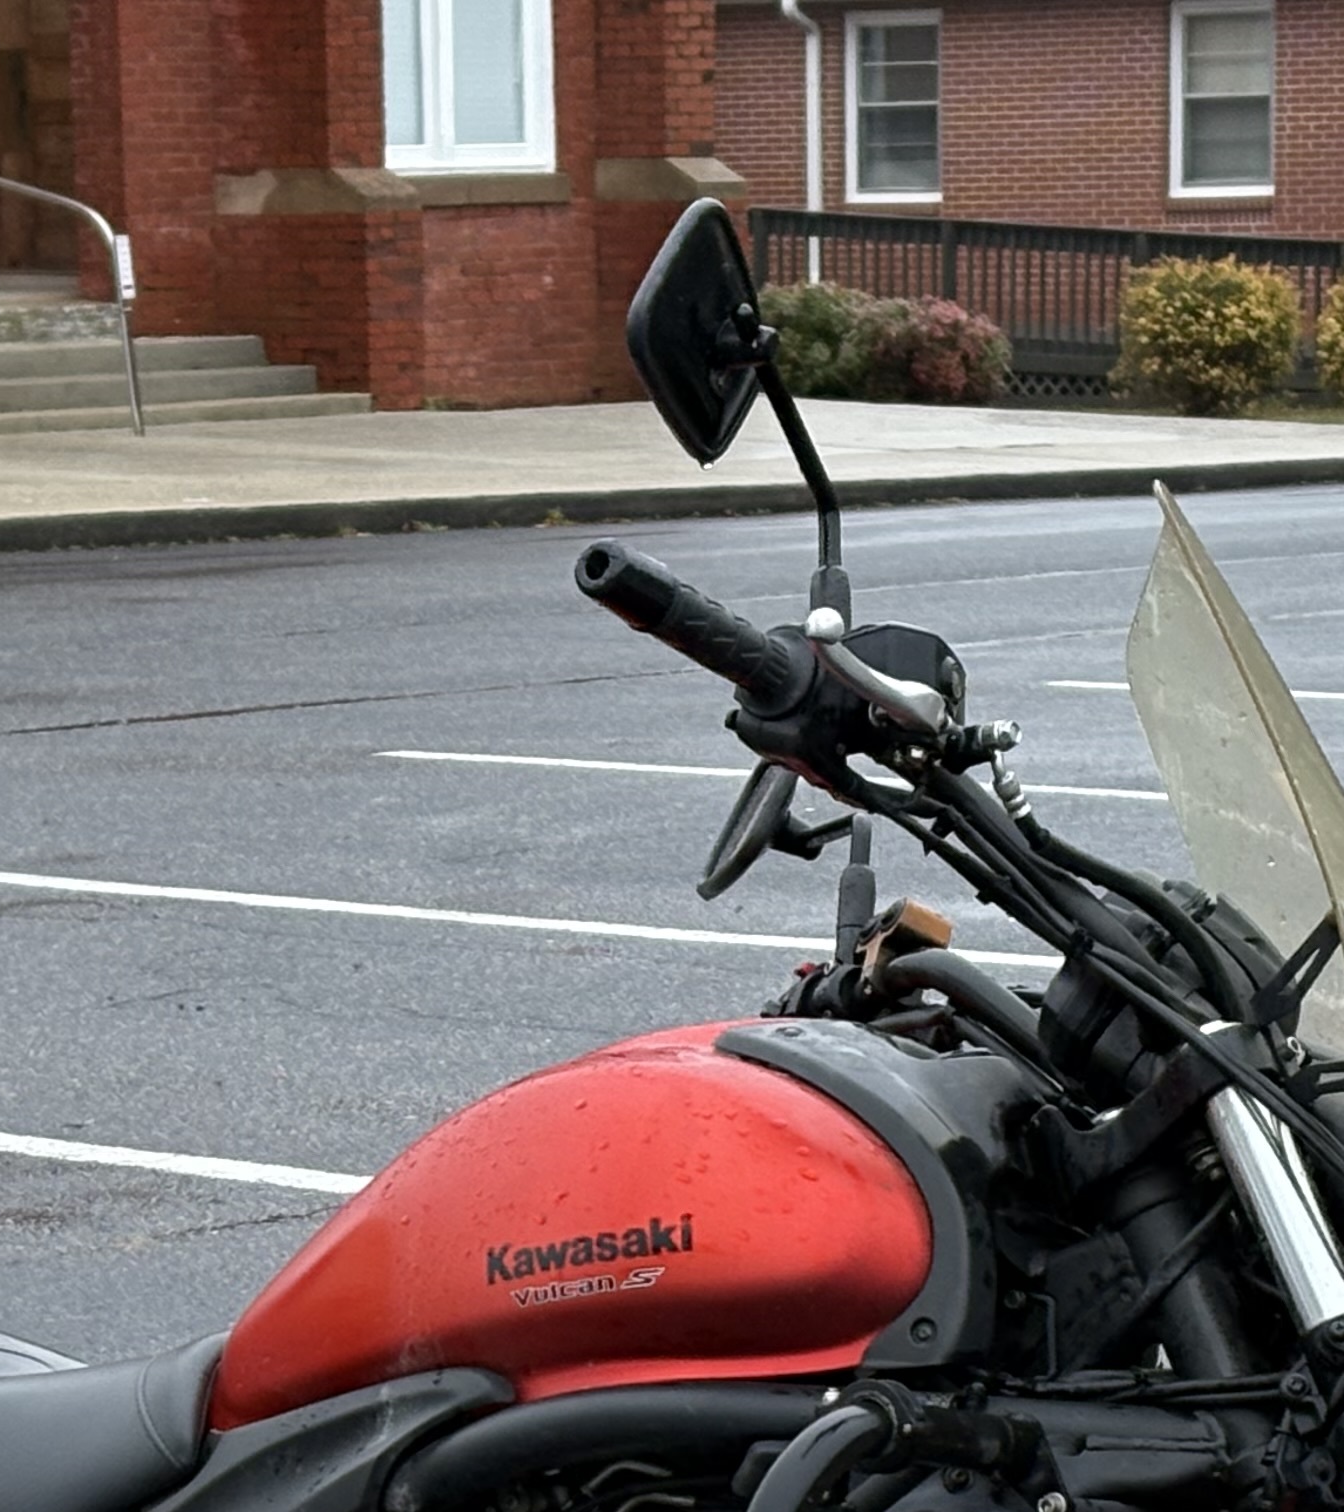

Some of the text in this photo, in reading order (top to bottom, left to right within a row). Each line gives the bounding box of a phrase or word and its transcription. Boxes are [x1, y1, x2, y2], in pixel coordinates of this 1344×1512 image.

[487, 1213, 693, 1285] Kawasaki
[510, 1266, 666, 1308] Vulcan S
